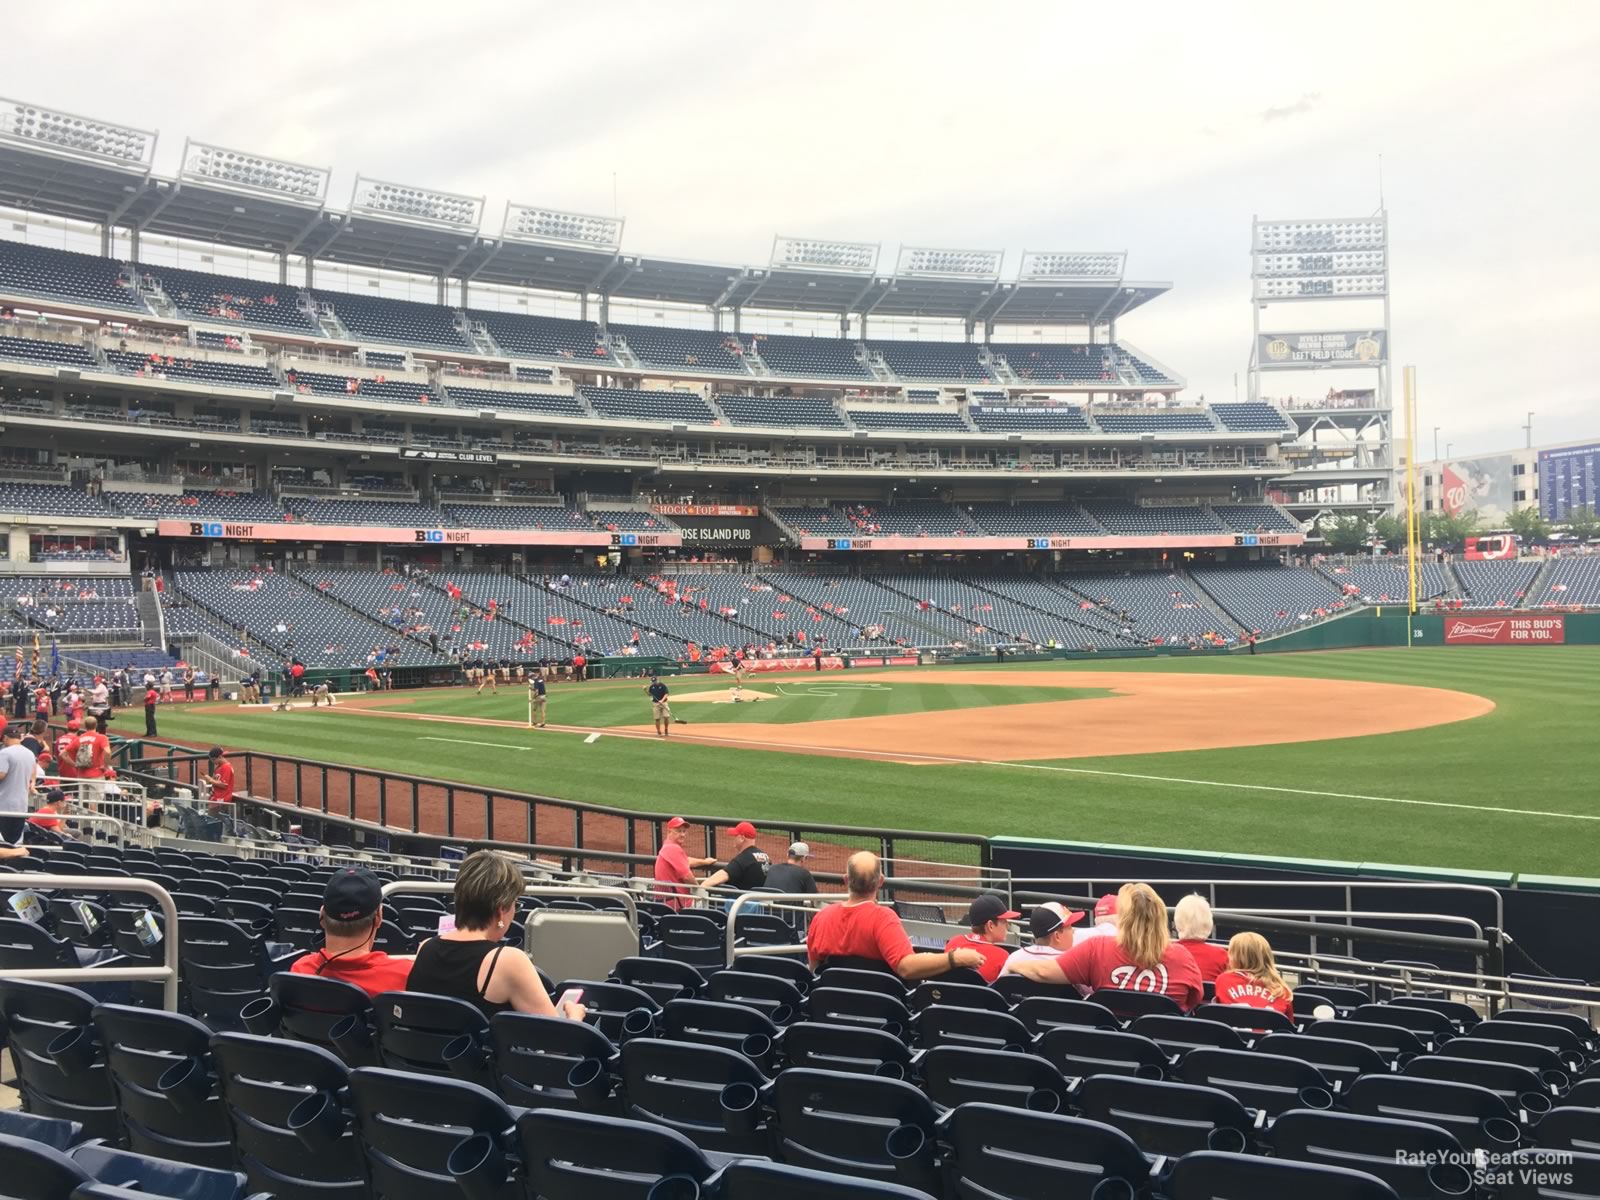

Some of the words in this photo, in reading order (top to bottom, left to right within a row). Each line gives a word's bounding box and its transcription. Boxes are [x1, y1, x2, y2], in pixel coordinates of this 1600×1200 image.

[1292, 351, 1309, 360] LEFT
[1311, 350, 1330, 359] FIELD
[1331, 350, 1354, 359] LODGE
[459, 453, 474, 461] CLUB
[475, 454, 494, 462] LEVEL
[651, 505, 688, 515] SHOCK
[694, 506, 715, 515] TOP
[225, 525, 254, 537] NIGHT
[681, 528, 698, 540] OSE
[700, 529, 732, 540] ISLAND
[733, 529, 751, 540] PUB
[446, 532, 470, 542] NIGHT
[638, 535, 659, 545] NIGHT
[1259, 536, 1279, 544] NIGHT
[852, 540, 872, 549] NIGHT
[1050, 539, 1071, 548] NIGHT
[1453, 625, 1500, 635] Budweiser
[1510, 620, 1532, 629] THIS
[1534, 620, 1562, 629] BUD'S
[1413, 629, 1423, 638] 336
[1510, 630, 1529, 639] FOR
[1531, 630, 1552, 639] YOU.
